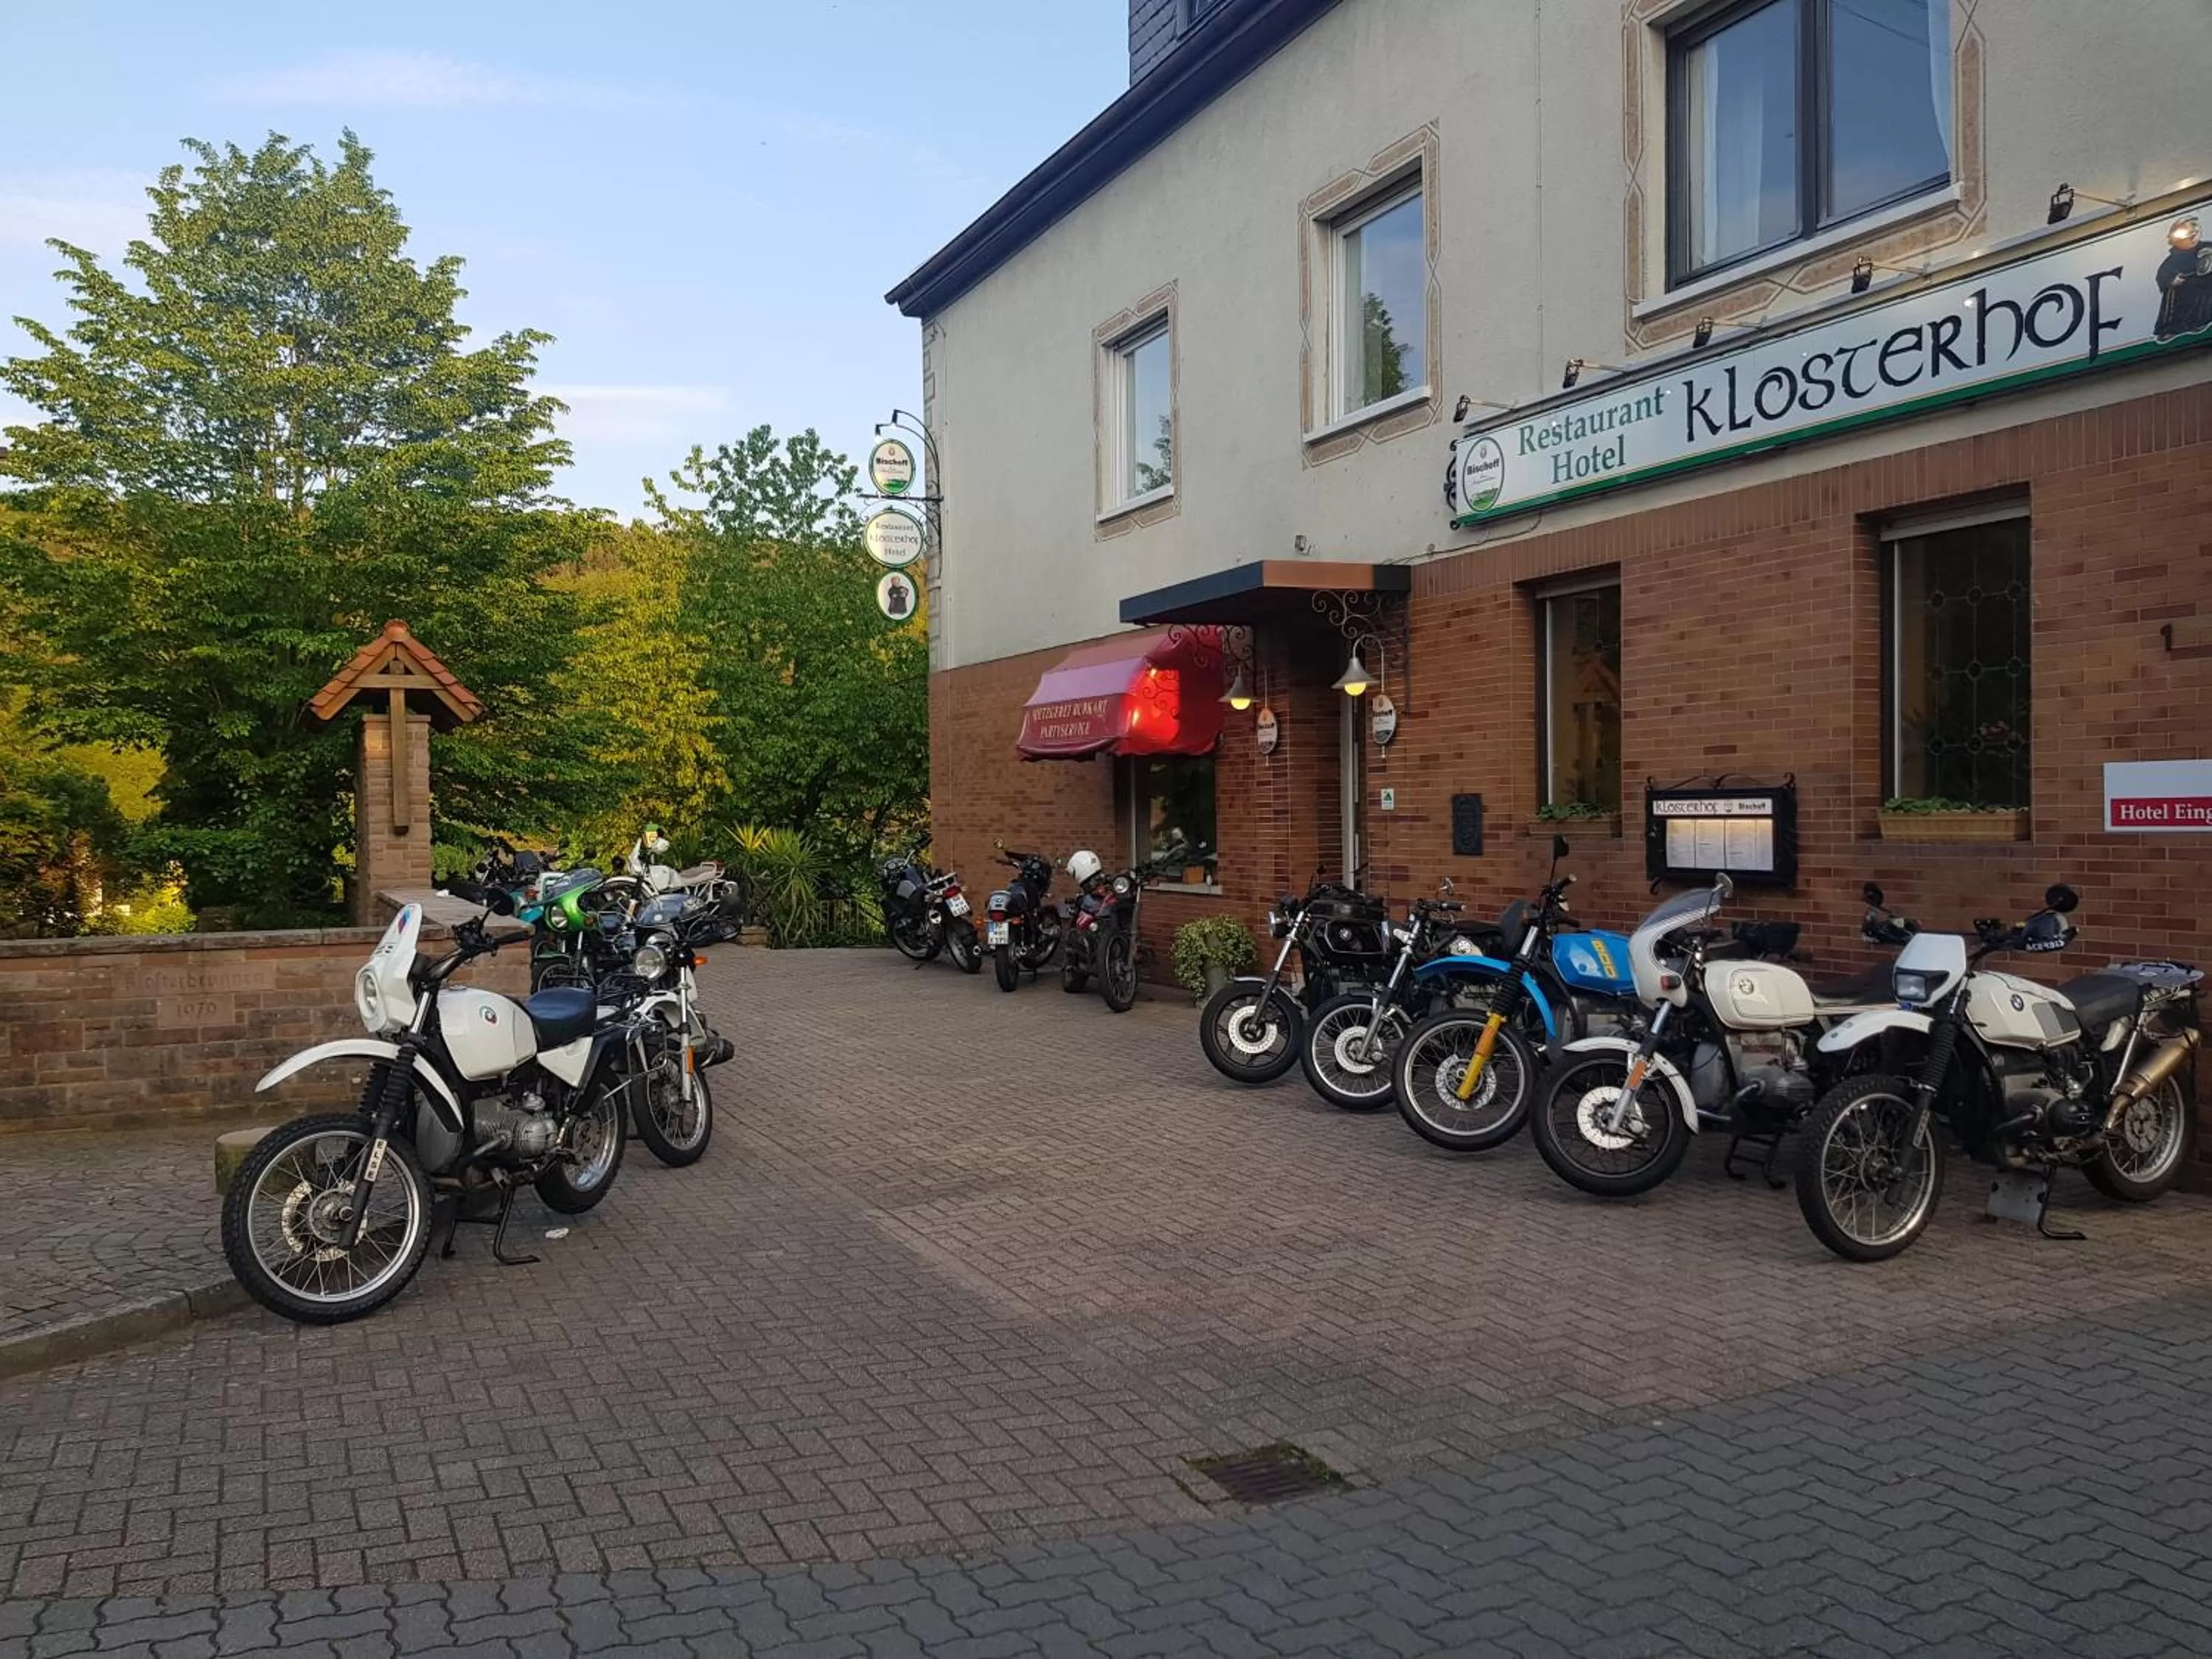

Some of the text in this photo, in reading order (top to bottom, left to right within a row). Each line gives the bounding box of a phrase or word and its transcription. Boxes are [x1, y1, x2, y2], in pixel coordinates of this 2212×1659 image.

[1517, 386, 1665, 456] Restaurant
[876, 457, 908, 466] Bischoff
[1467, 458, 1500, 476] Bischoff
[1551, 434, 1627, 484] Hotel
[1738, 802, 1766, 810] Bischoff
[2120, 804, 2168, 820] Hotel
